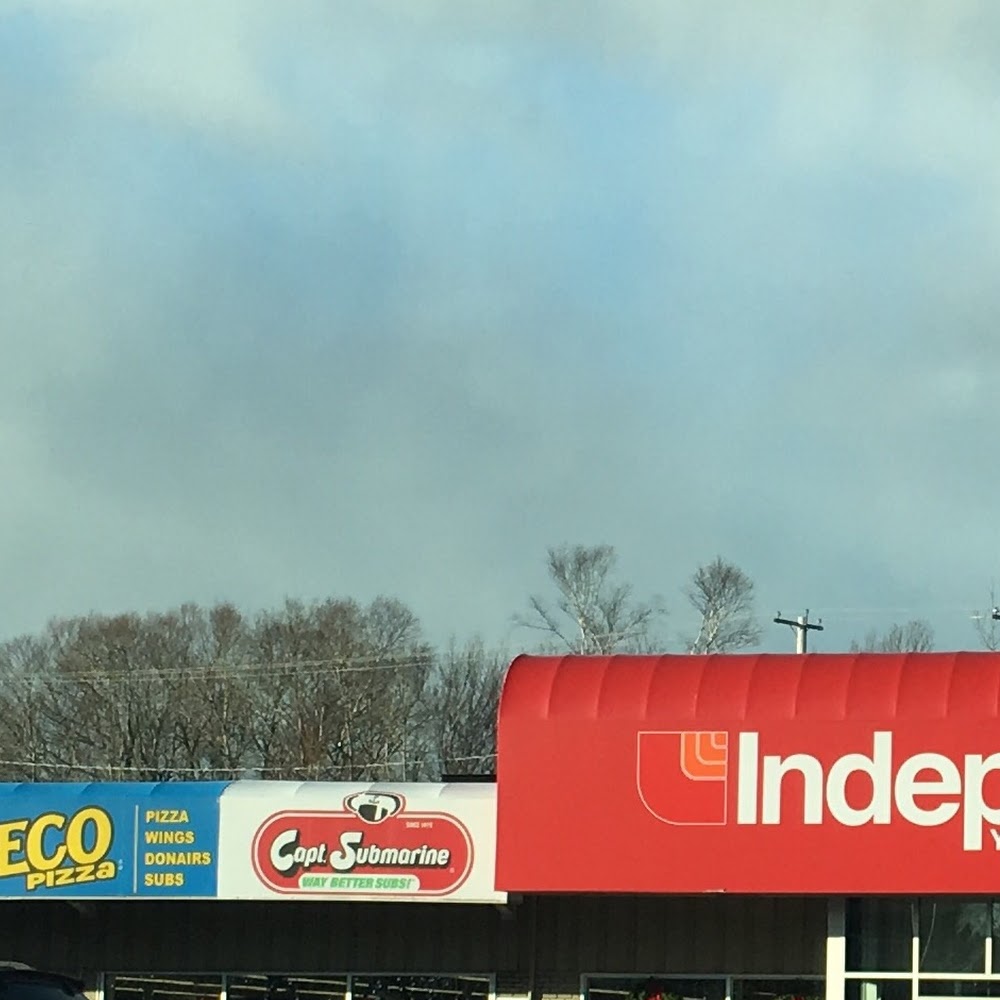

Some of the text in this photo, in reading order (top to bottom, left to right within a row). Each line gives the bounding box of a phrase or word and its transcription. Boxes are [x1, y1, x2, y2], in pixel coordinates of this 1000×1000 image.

[144, 810, 189, 824] PIZZA
[144, 830, 195, 844] WINGS
[329, 831, 450, 871] Submarine
[144, 851, 211, 866] DONAIRS
[144, 872, 184, 887] SUBS
[302, 877, 412, 889] WAY BETTER SUBS!
